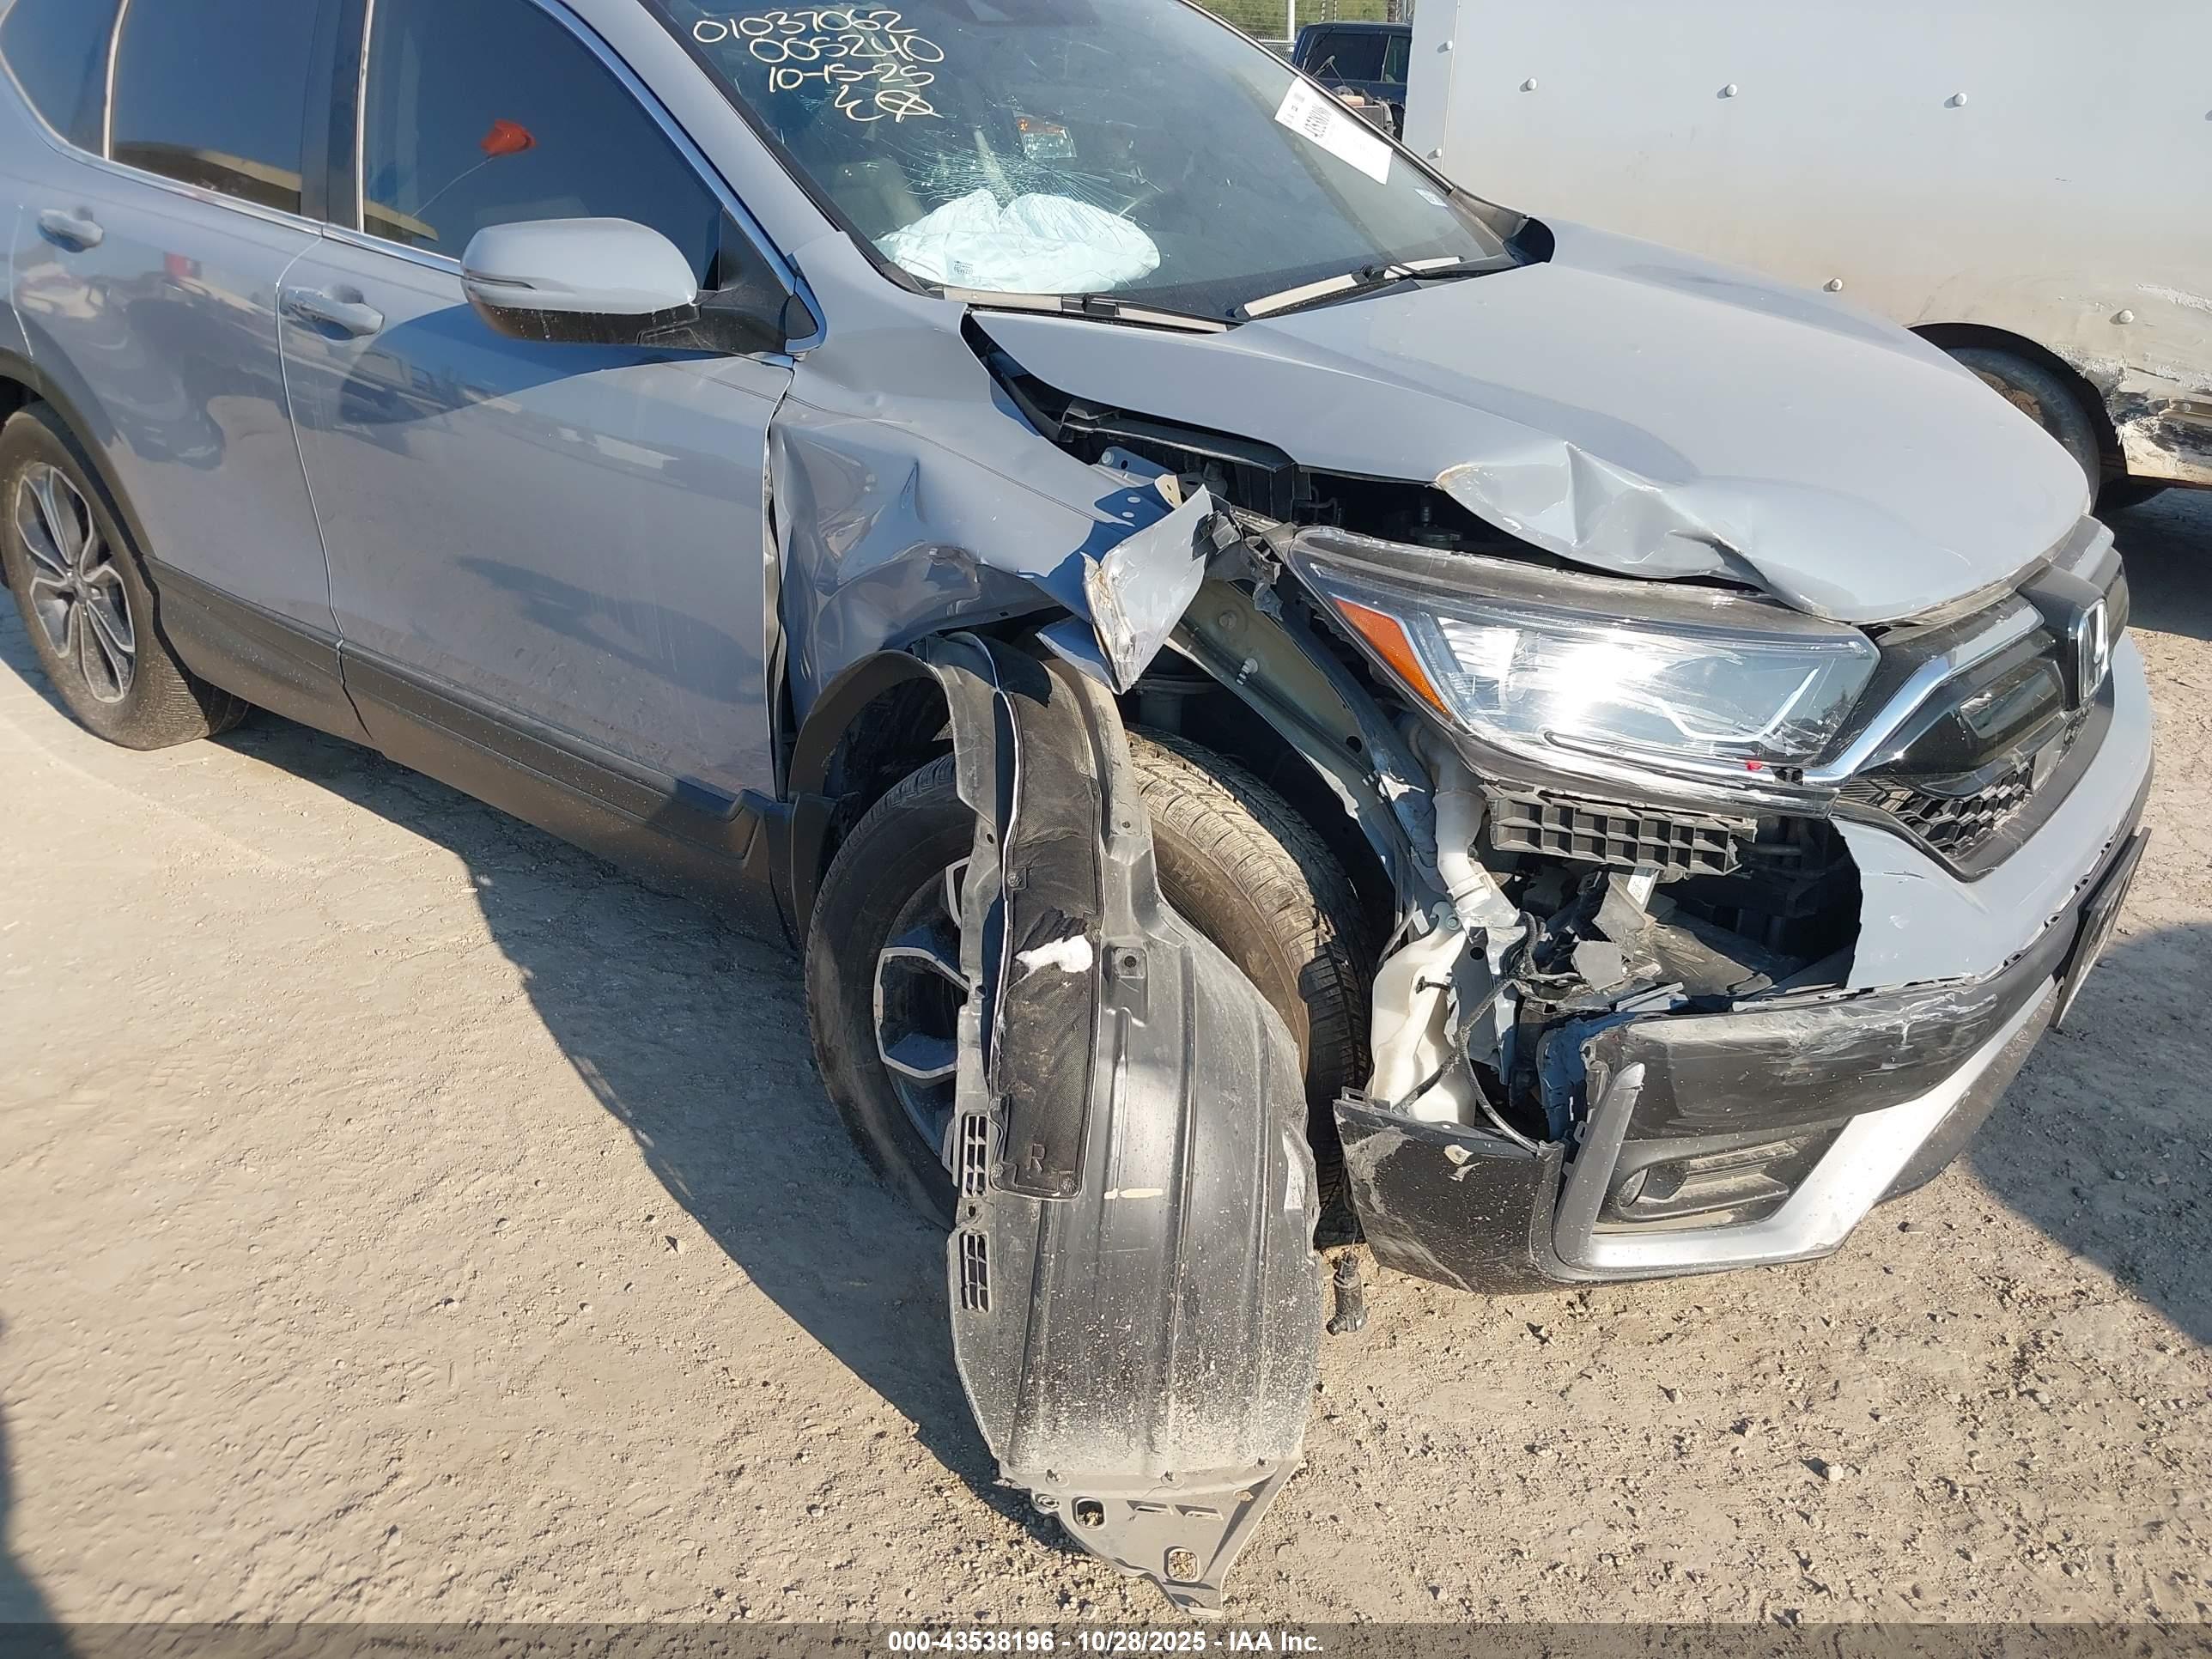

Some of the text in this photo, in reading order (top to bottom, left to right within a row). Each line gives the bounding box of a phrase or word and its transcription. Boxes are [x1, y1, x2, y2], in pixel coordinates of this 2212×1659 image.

[693, 9, 920, 43] 01037062
[749, 33, 945, 63] 005240
[769, 63, 935, 93] 10-15-25
[1029, 1143, 1047, 1174] R
